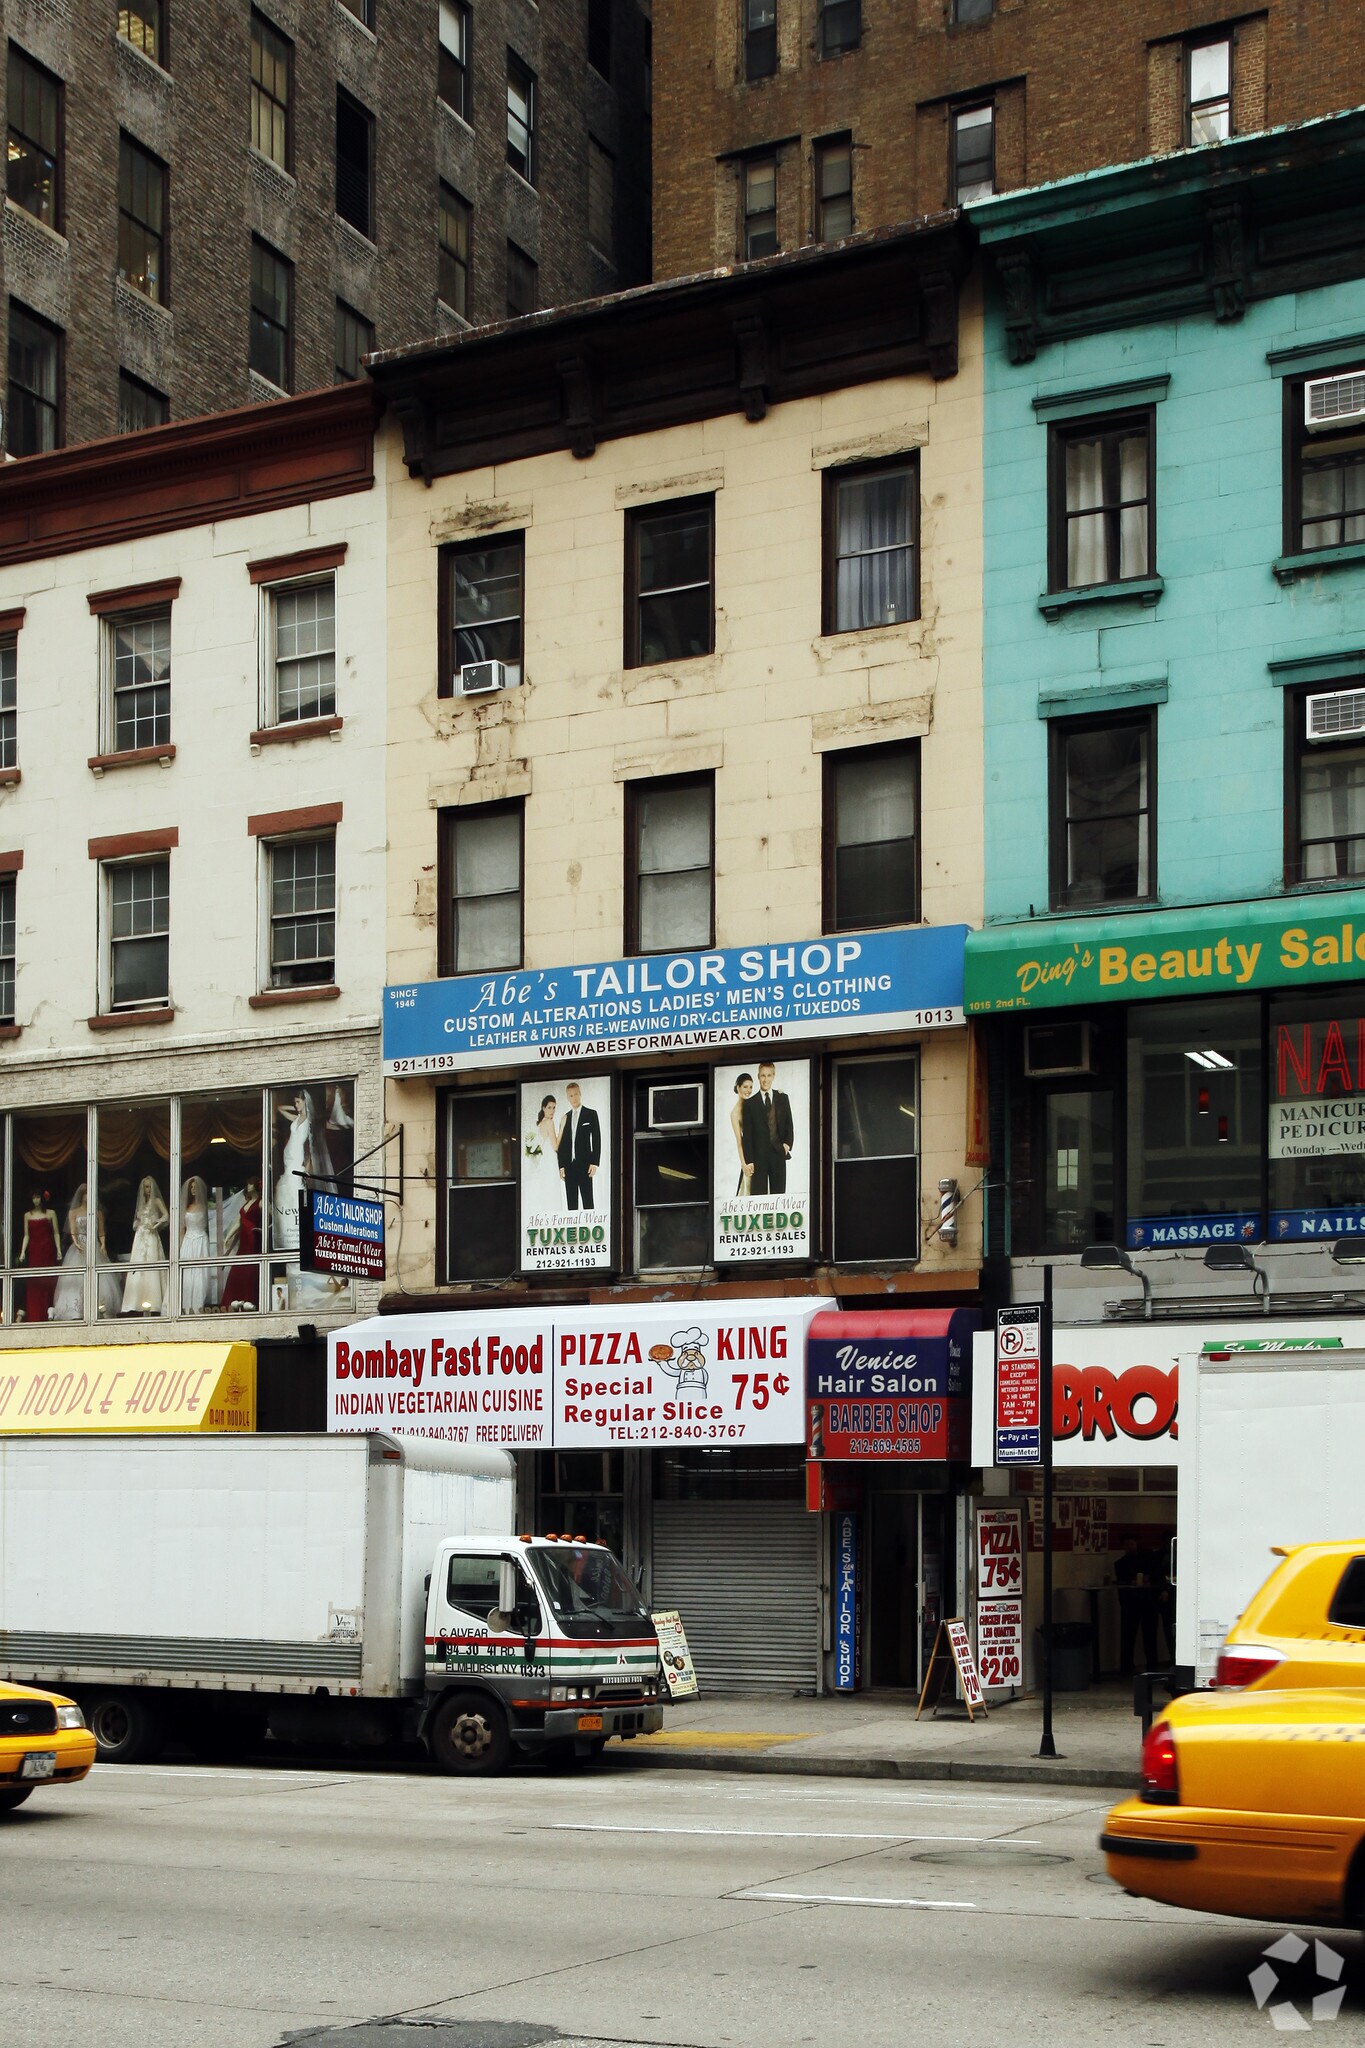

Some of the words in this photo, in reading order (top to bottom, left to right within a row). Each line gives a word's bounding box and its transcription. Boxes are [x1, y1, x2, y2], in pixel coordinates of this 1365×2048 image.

[1016, 944, 1094, 992] Ding's
[1100, 937, 1262, 986] Beauty
[470, 972, 558, 1012] Abe's
[573, 955, 727, 998] TAILOR
[739, 941, 862, 982] SHOP
[390, 988, 418, 999] SINCE
[395, 999, 416, 1008] 1946
[444, 1012, 515, 1033] CUSTOM
[521, 1000, 642, 1026] ALTERATIONS
[649, 992, 720, 1014] LADIES'
[727, 986, 784, 1005] MEN'S
[792, 974, 892, 998] CLOTHING
[969, 1001, 992, 1011] 1015
[996, 998, 1014, 1009] 2nd
[470, 1030, 528, 1048] LEATHER
[531, 1030, 538, 1042] &
[542, 1026, 576, 1040] FURS
[586, 1016, 670, 1036] RE-WEAVING
[680, 1004, 782, 1028] DRY-CLEANING
[794, 998, 860, 1016] TUXEDOS
[914, 1009, 953, 1024] 1013
[538, 1025, 784, 1058] WWW.ABESFORMALWEAR.COM
[393, 1056, 454, 1073] 921-1193
[314, 1196, 340, 1220] Abe's
[342, 1202, 365, 1222] TAILOR
[366, 1210, 382, 1226] SHOP
[720, 1200, 744, 1216] Abe's
[746, 1198, 778, 1212] Formal
[780, 1196, 806, 1210] Wear
[319, 1218, 344, 1232] Custom
[344, 1223, 378, 1240] Alterations
[526, 1214, 550, 1228] Abe's
[552, 1212, 582, 1225] Formal
[584, 1212, 608, 1224] Wear
[720, 1212, 804, 1234] TUXEDO
[527, 1226, 605, 1246] TUXEDO
[720, 1234, 762, 1244] RENTALS
[766, 1232, 772, 1242] &
[776, 1231, 806, 1240] SALES
[1152, 1224, 1235, 1242] MASSAGE
[316, 1236, 336, 1250] Abe's
[336, 1239, 362, 1254] Formal
[363, 1244, 382, 1256] Wear
[526, 1246, 566, 1256] RENTALS
[570, 1246, 576, 1254] &
[578, 1244, 607, 1254] SALES
[730, 1246, 794, 1256] 212-921-1193
[315, 1249, 336, 1260] TUXEDO
[338, 1252, 361, 1264] RENTALS
[366, 1257, 382, 1268] SALES
[536, 1258, 596, 1268] 212-921-1193
[331, 1262, 368, 1276] 212-921-1193
[560, 1332, 642, 1366] PIZZA
[716, 1326, 788, 1360] KING
[336, 1340, 426, 1388] Bombay
[431, 1336, 481, 1376] Fast
[487, 1334, 543, 1375] Food
[836, 1344, 918, 1371] Venice
[1002, 1364, 1009, 1372] NO
[18, 1372, 126, 1416] NOODLE
[125, 1369, 212, 1414] HOUSE
[565, 1376, 652, 1400] Special
[732, 1372, 790, 1410] 75¢
[818, 1375, 864, 1392] Hair
[870, 1374, 936, 1392] Salon
[336, 1393, 384, 1416] INDIAN
[388, 1390, 478, 1414] VEGETARIAN
[482, 1388, 543, 1412] CUISINE
[1022, 1400, 1036, 1408] 7PM
[1052, 1364, 1178, 1442] BRO
[210, 1408, 224, 1425] MAIN
[228, 1410, 250, 1426] NOODLE
[564, 1403, 656, 1426] Regular
[662, 1402, 723, 1420] Slice
[830, 1404, 894, 1433] BARBER
[898, 1403, 942, 1432] SHOP
[476, 1424, 499, 1442] FREE
[501, 1424, 544, 1442] DELIVERY
[609, 1424, 746, 1440] TEL:212-840-3767
[1008, 1434, 1020, 1442] Pay
[850, 1438, 921, 1454] 212-869-4585
[999, 1448, 1038, 1456] Muni-Meter
[842, 1516, 852, 1563] ABE'S
[980, 1525, 1020, 1555] PIZZA
[981, 1557, 1020, 1588] .75¢
[840, 1571, 852, 1634] TAILOR
[450, 1628, 488, 1638] ALVEAR
[487, 1643, 496, 1656] 41
[500, 1646, 516, 1656] RD.
[520, 1665, 546, 1678] 11373
[840, 1643, 850, 1686] SHOP
[980, 1656, 1020, 1685] $2.00
